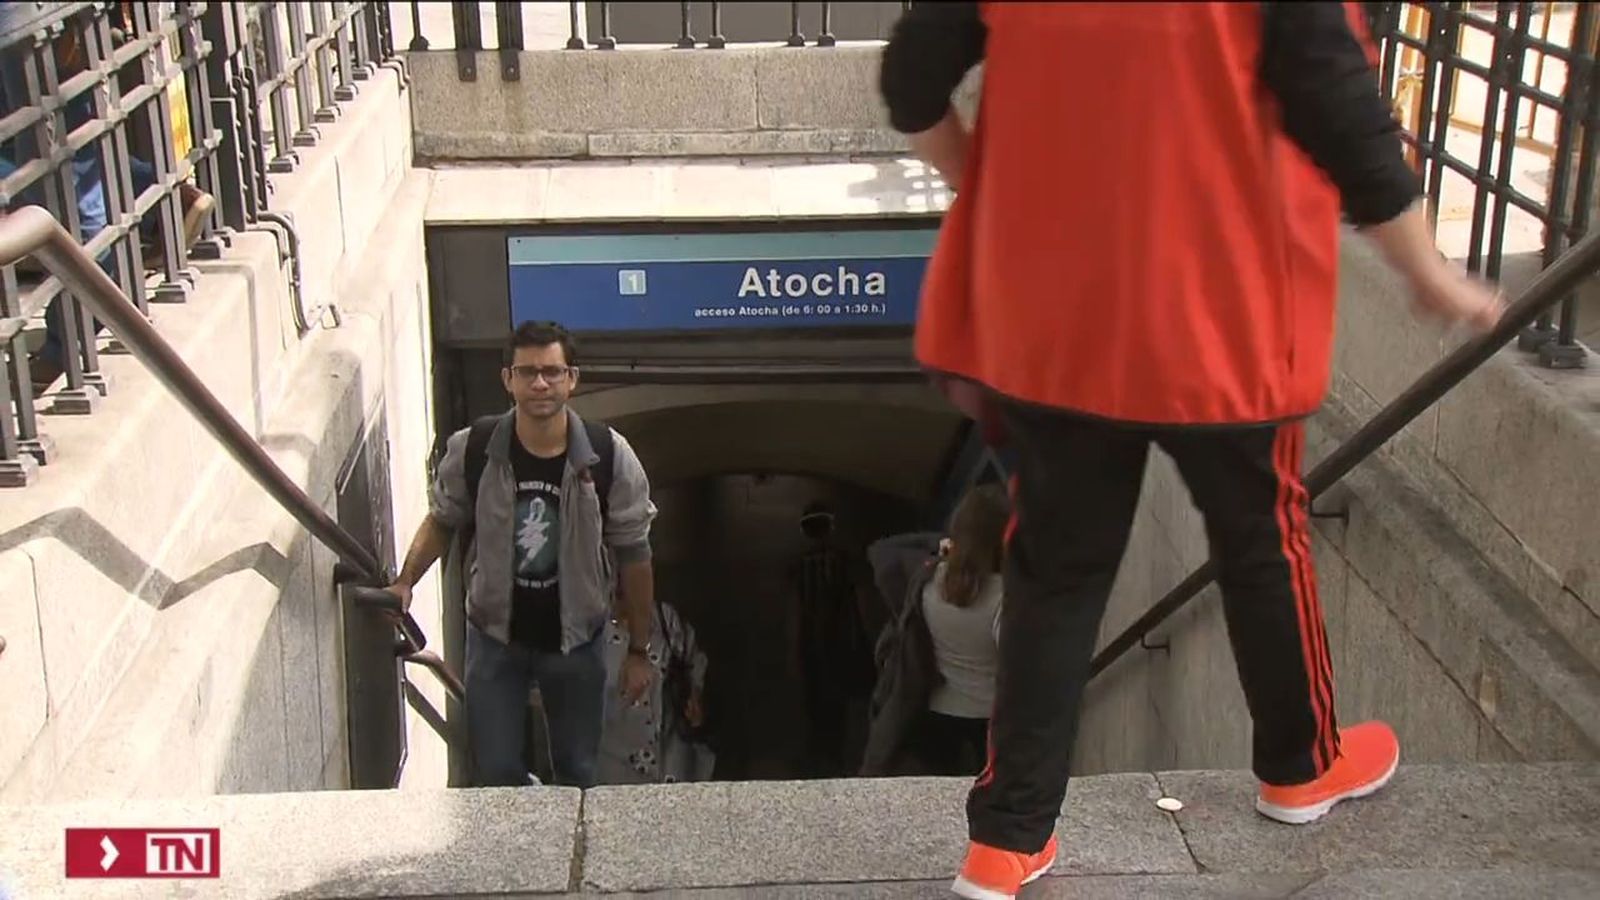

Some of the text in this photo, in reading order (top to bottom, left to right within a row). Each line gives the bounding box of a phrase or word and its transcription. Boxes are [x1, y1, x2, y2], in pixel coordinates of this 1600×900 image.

[738, 266, 886, 298] Atocha
[694, 308, 736, 318] acceso
[739, 306, 779, 316] Atocha
[782, 305, 800, 317] (de
[817, 304, 831, 314] 00
[834, 306, 841, 314] a
